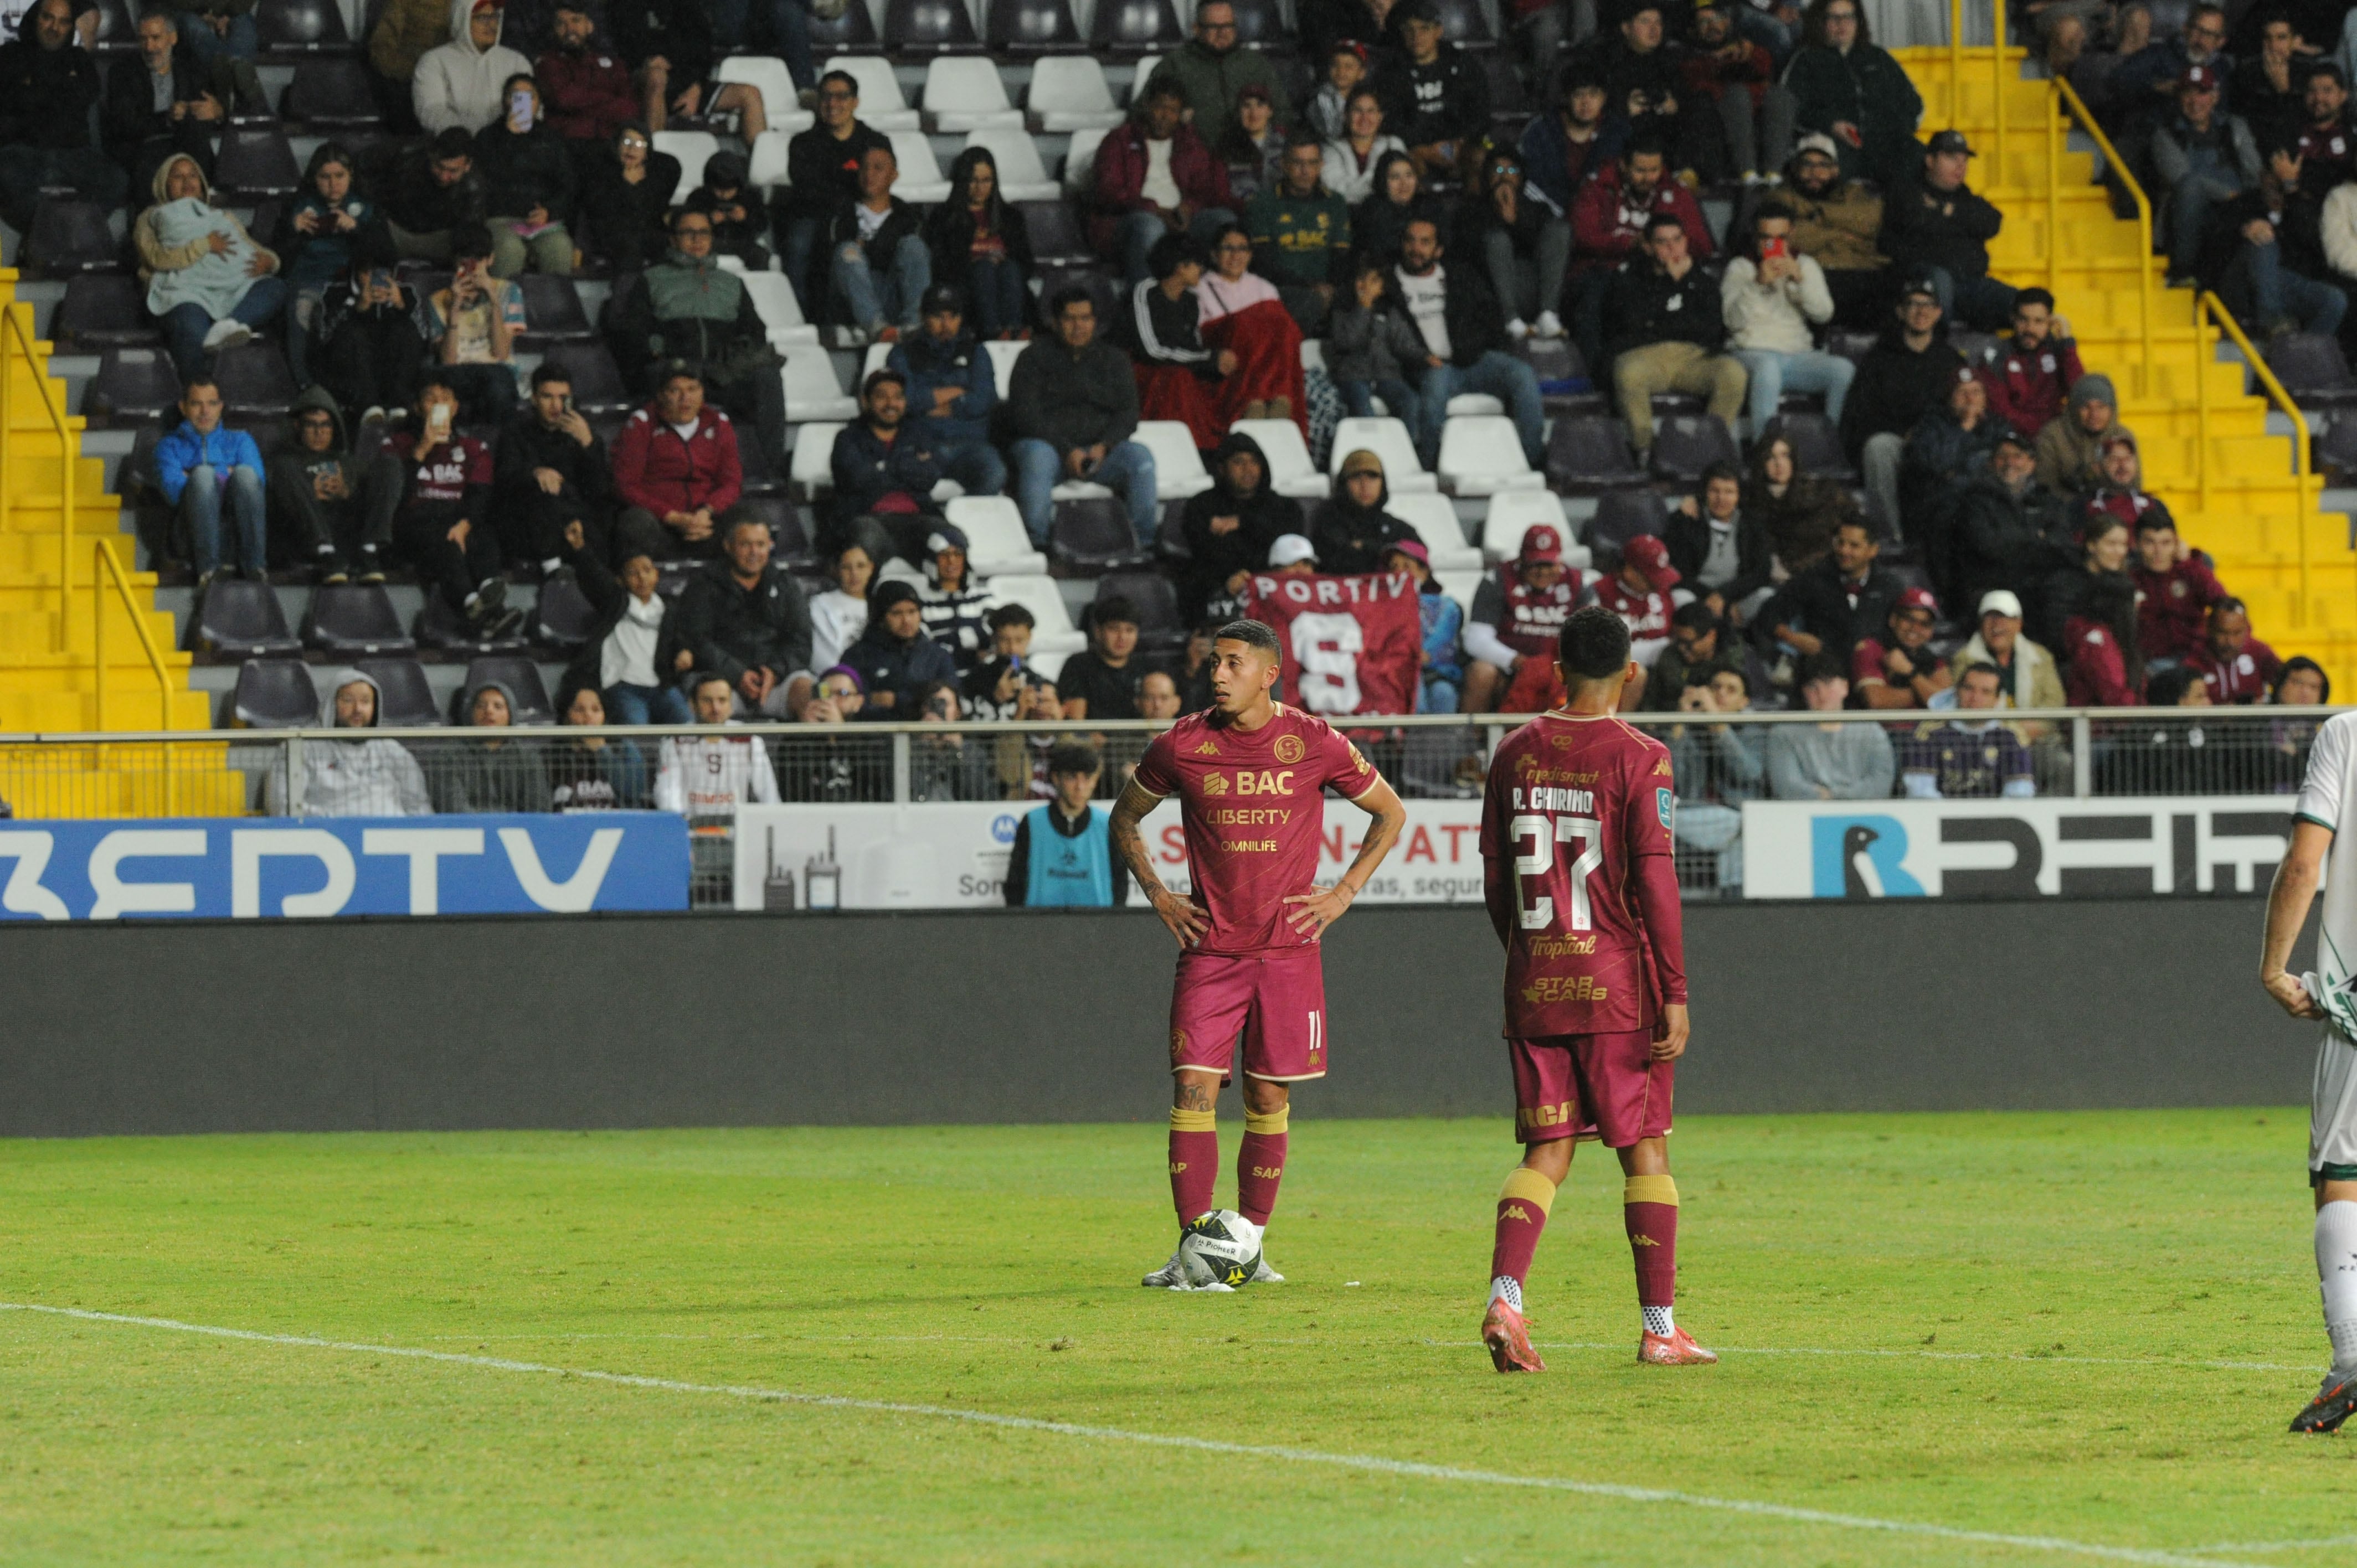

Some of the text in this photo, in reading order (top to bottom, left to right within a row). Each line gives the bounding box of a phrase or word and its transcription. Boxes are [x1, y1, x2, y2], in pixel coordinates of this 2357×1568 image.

[1237, 571, 1419, 607] PORTIV
[1237, 771, 1294, 795] BAC
[1513, 787, 1594, 813] R. CHIRINO
[1207, 809, 1291, 824] LIBERTY
[1221, 840, 1277, 852] OMNILIFE
[1510, 816, 1602, 930] 27
[1529, 933, 1597, 959] Tropical
[1535, 976, 1593, 990] STAR
[1544, 987, 1607, 1001] CARS
[1309, 1010, 1321, 1050] 11
[1519, 1100, 1576, 1128] RCA
[1169, 1163, 1187, 1174] AP
[1252, 1167, 1281, 1179] SAP
